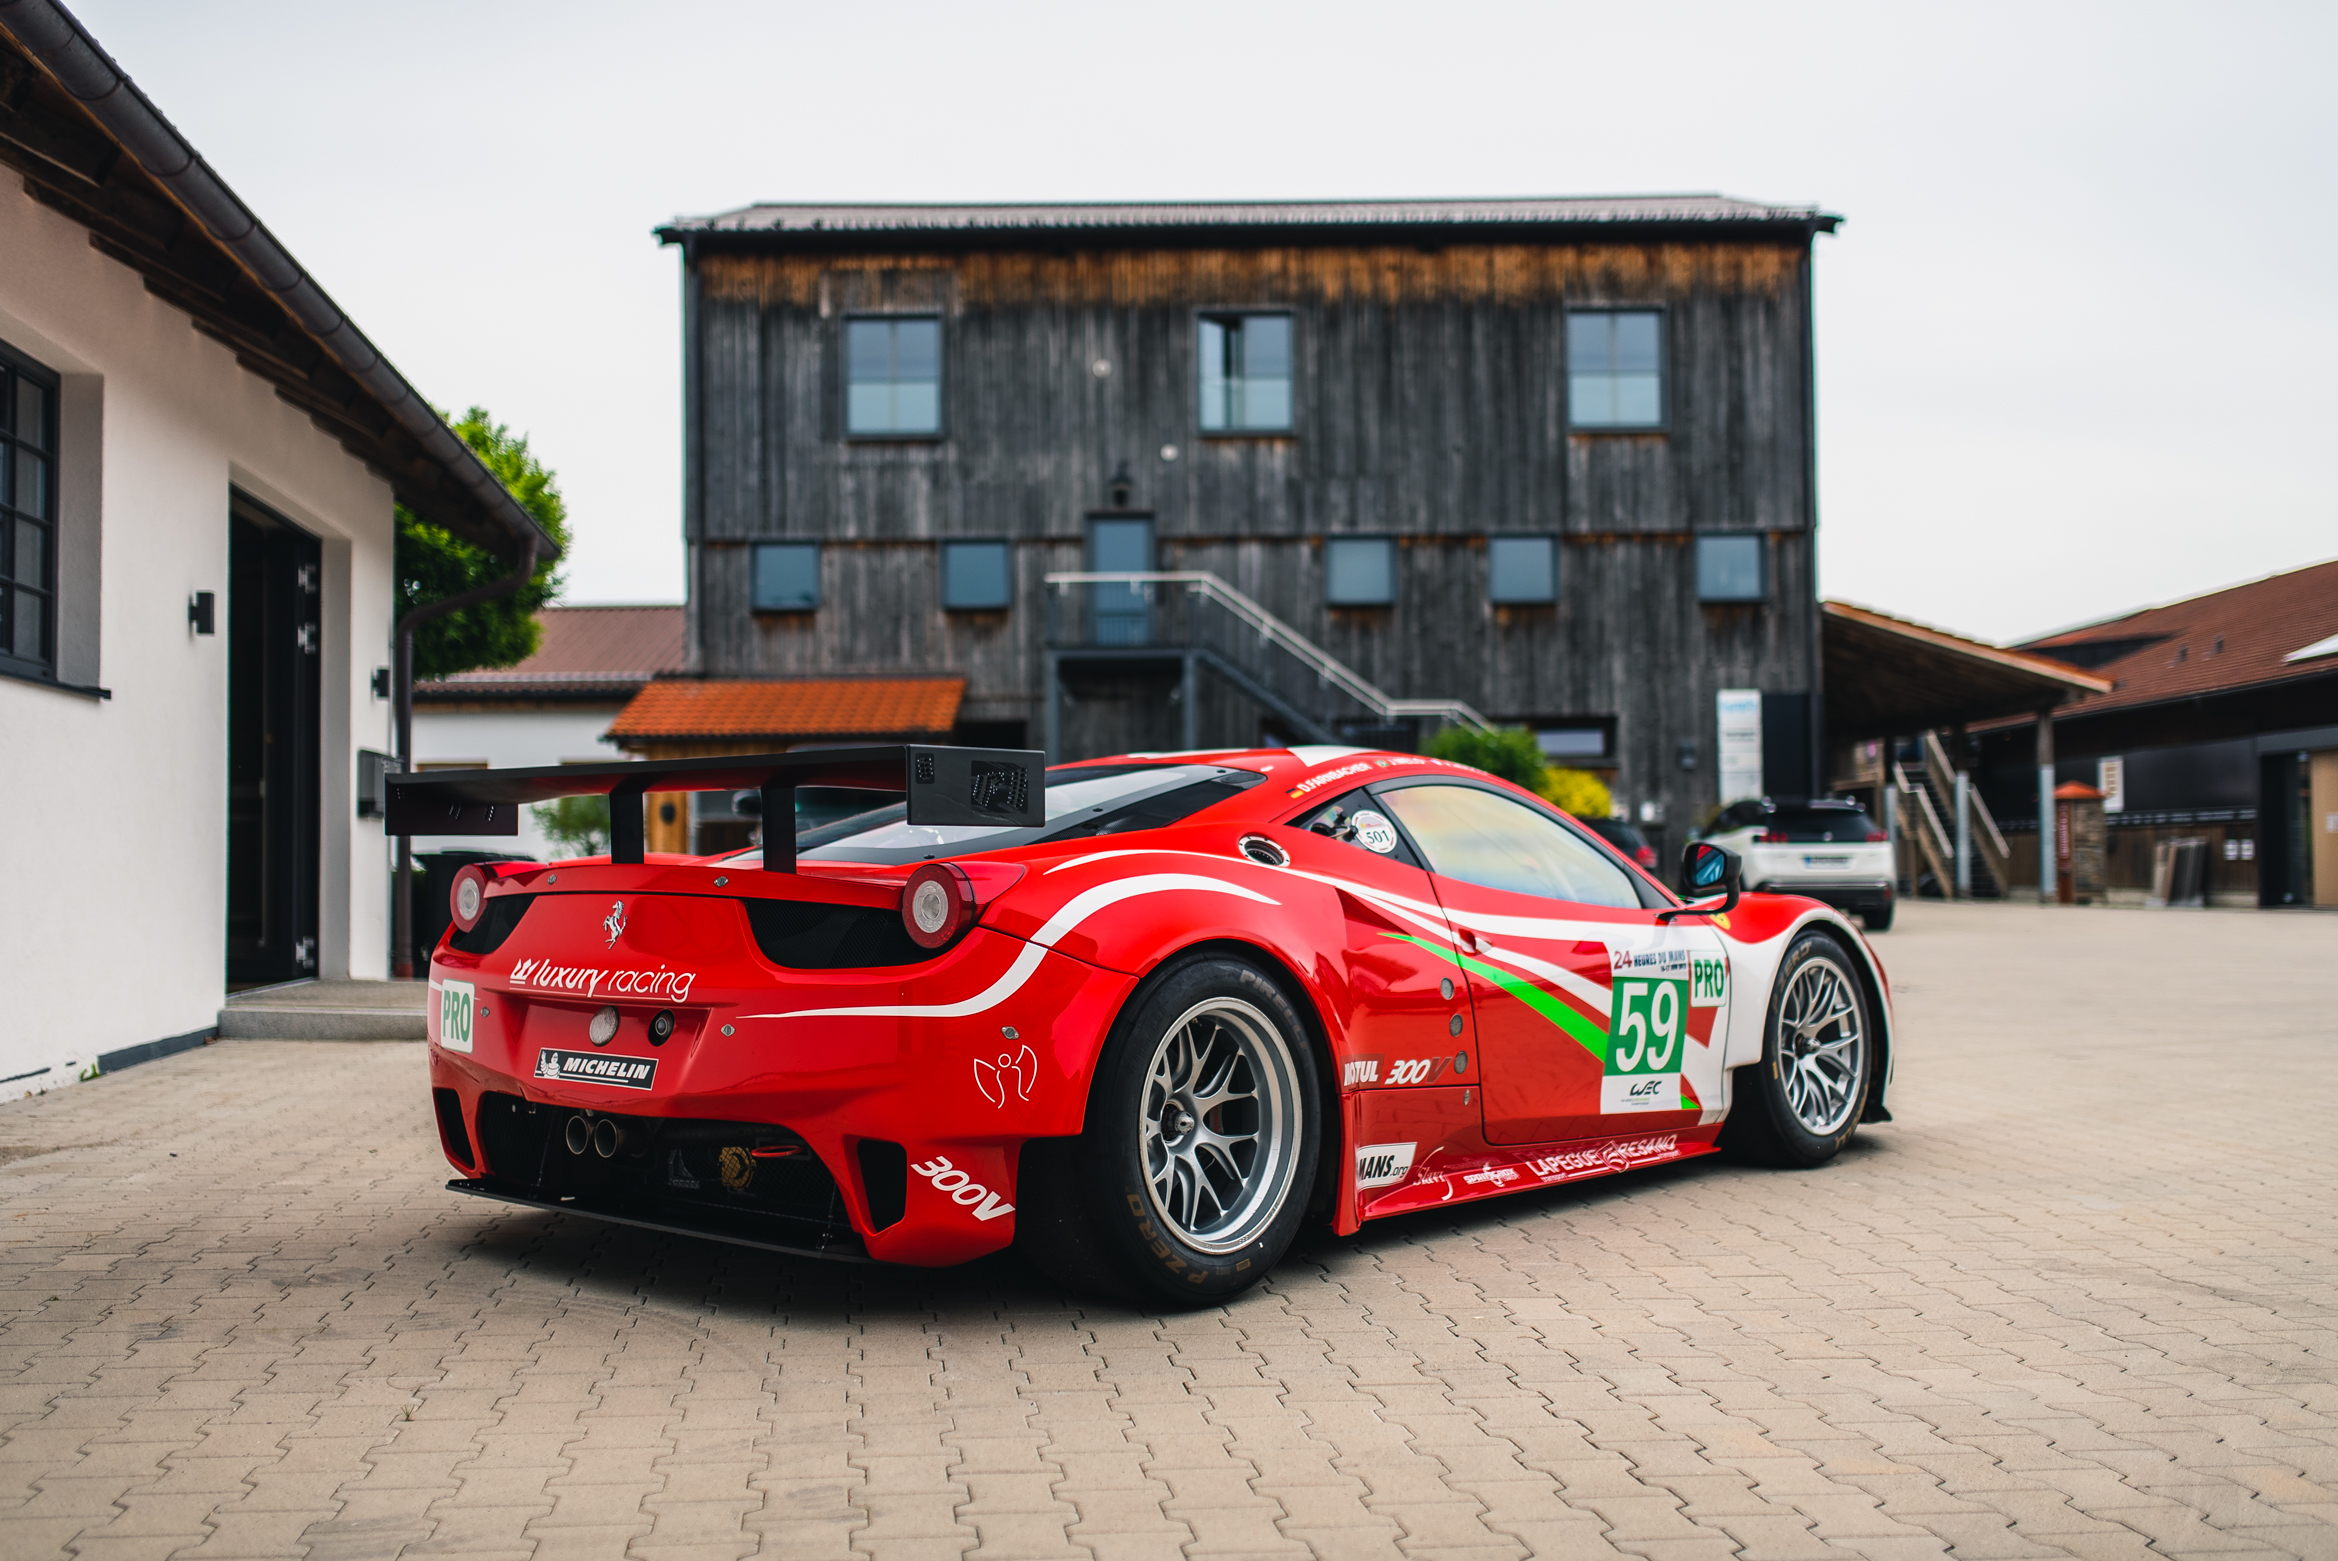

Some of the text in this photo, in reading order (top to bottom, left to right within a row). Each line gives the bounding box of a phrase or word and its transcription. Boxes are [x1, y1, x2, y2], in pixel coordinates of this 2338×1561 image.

[1296, 762, 1373, 793] D.FARNBACHER
[1366, 829, 1390, 844] 501
[1613, 949, 1686, 970] 24 HEURES DU MANS
[1693, 958, 1725, 999] PRO
[532, 958, 697, 1003] luxury racing
[443, 989, 471, 1043] PRO
[1239, 969, 1309, 1050] PIRELLI
[1615, 980, 1679, 1073] 59
[562, 1056, 651, 1081] MICHELIN
[1343, 1060, 1379, 1087] MOTUL
[1384, 1056, 1453, 1085] 300V
[1629, 1080, 1662, 1097] WEC
[1525, 1133, 1679, 1177] LAPEGUE RESANO
[910, 1155, 1016, 1222] 300V
[1126, 1193, 1188, 1275] ZERO
